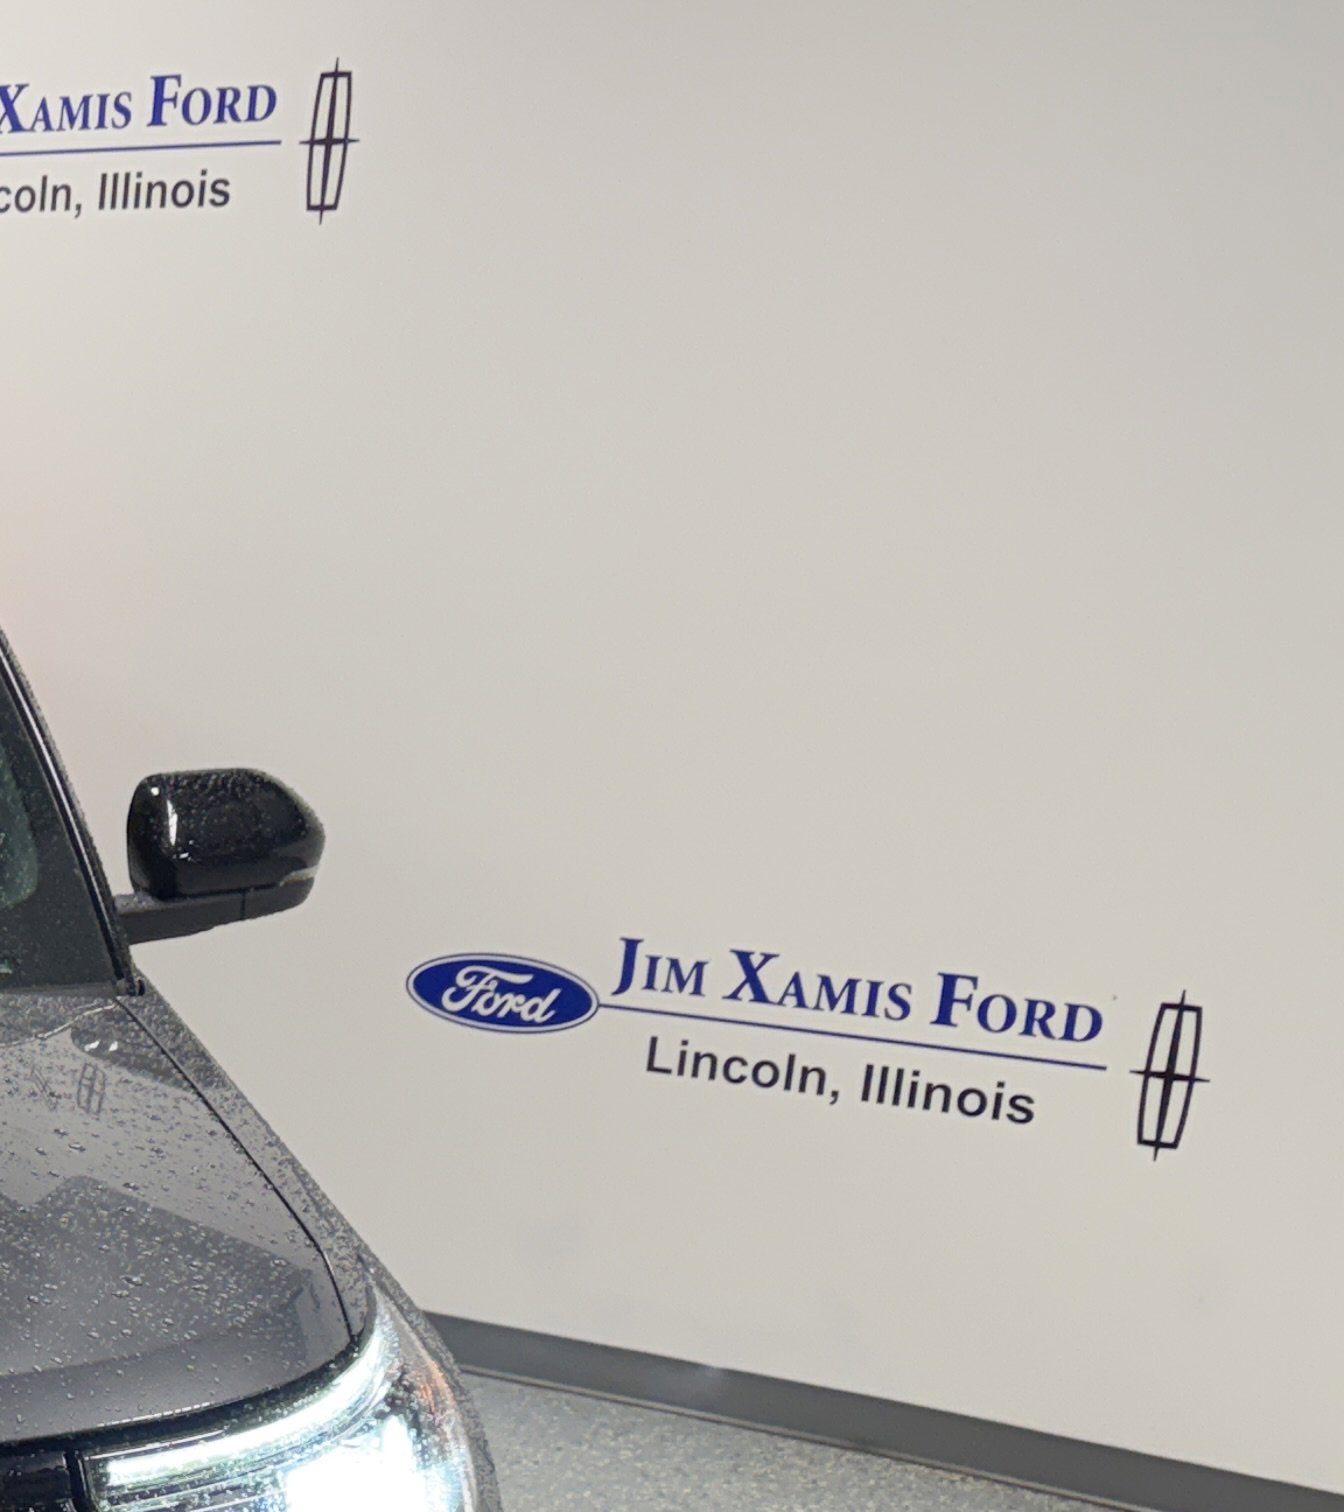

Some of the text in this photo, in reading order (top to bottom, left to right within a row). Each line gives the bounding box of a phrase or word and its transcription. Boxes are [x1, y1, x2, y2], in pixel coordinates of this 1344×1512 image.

[97, 169, 231, 211] Illinois
[441, 965, 561, 1026] Ford
[645, 1035, 1036, 1126] Lincoln, Illinois
